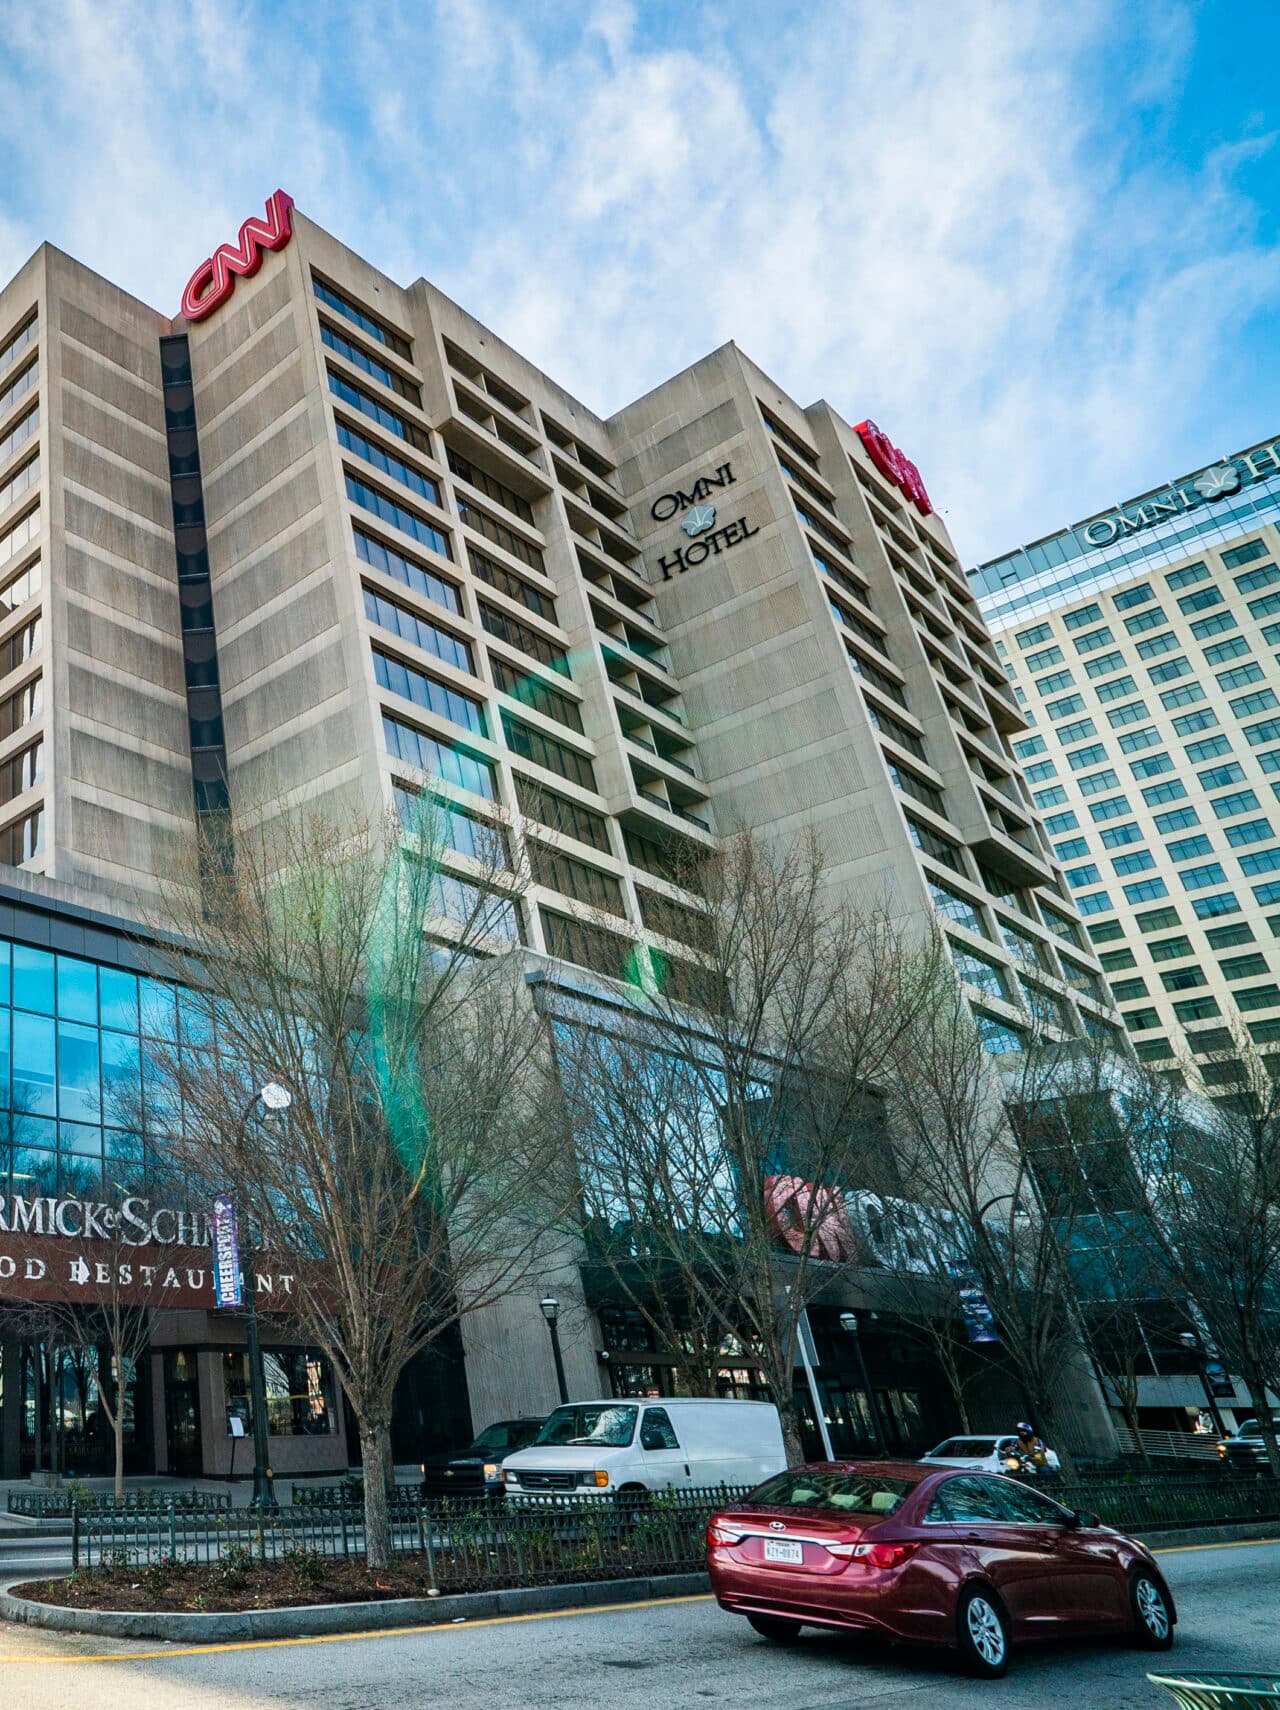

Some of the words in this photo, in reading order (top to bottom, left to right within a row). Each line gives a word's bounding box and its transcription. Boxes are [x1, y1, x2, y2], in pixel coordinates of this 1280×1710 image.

[181, 188, 294, 321] CNN
[651, 462, 737, 521] OMNI
[1084, 489, 1195, 548] OMNI
[657, 517, 760, 581] HOTEL
